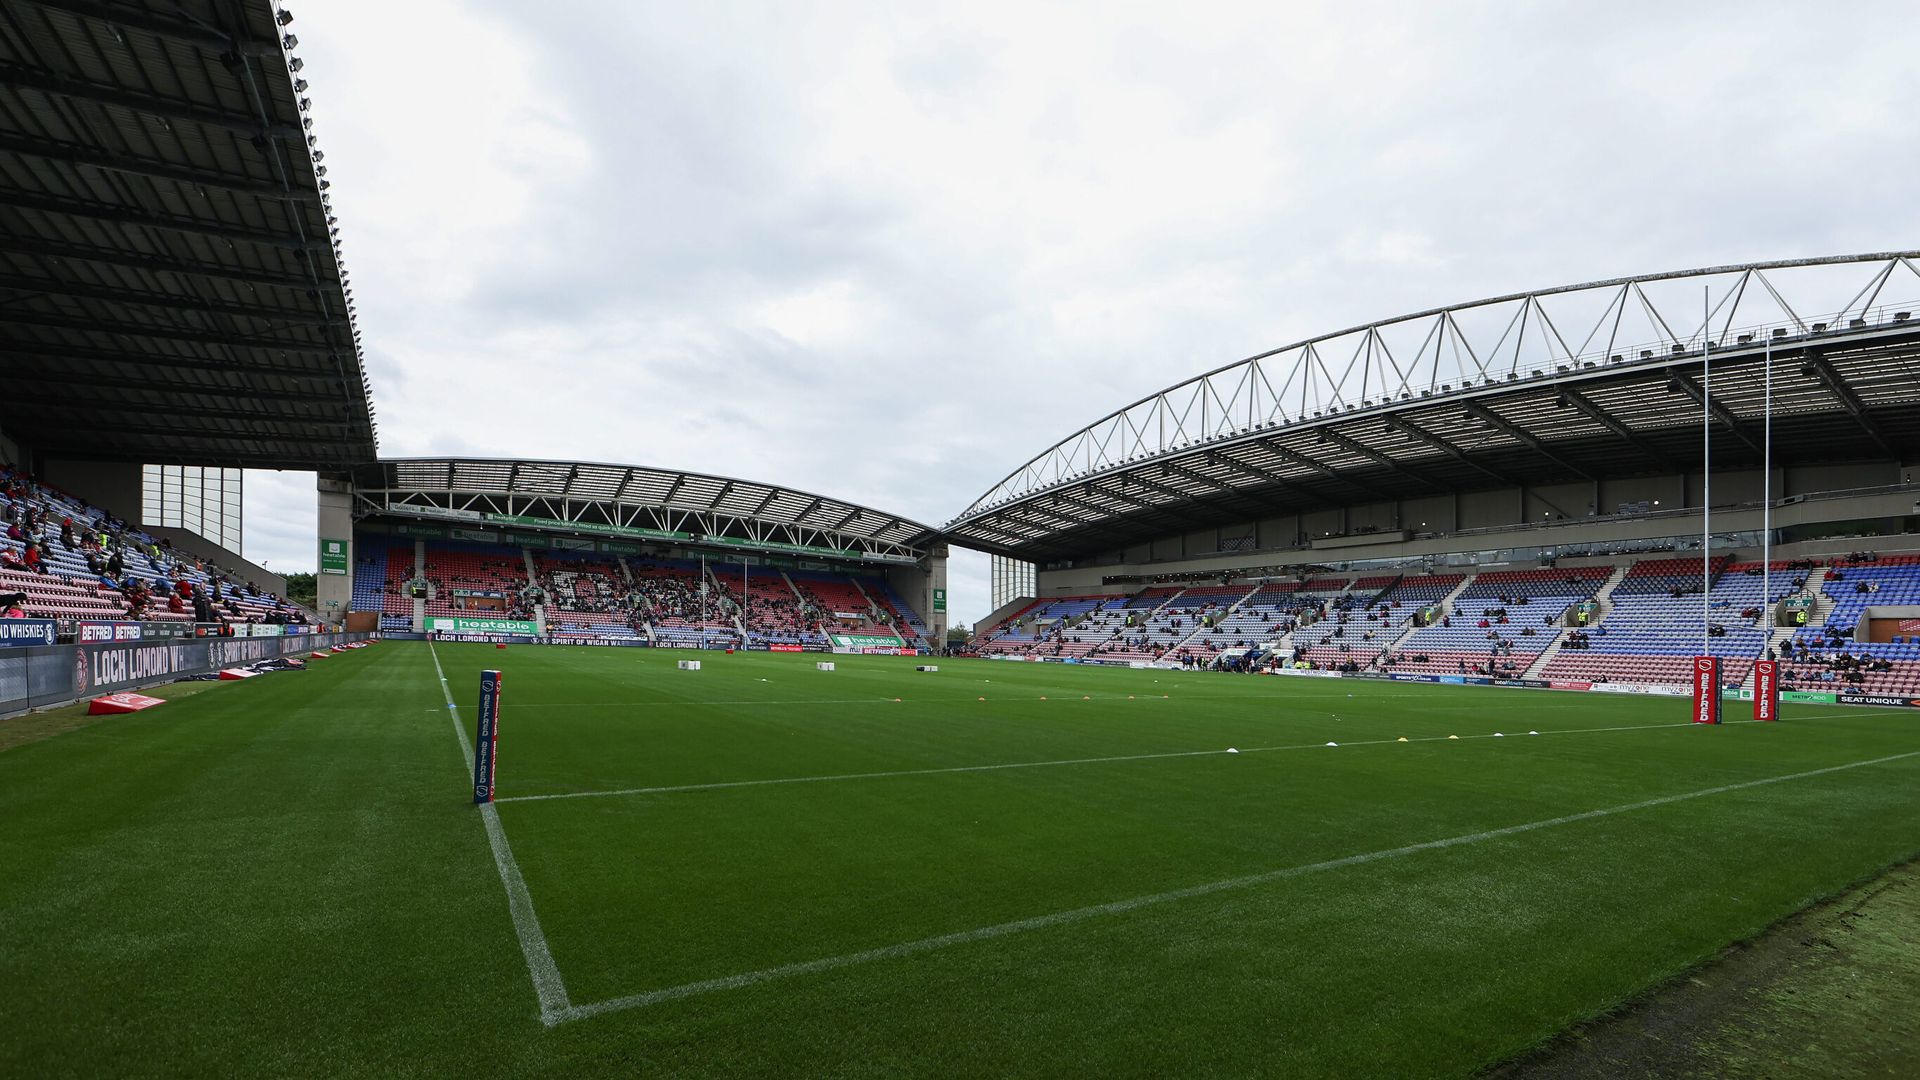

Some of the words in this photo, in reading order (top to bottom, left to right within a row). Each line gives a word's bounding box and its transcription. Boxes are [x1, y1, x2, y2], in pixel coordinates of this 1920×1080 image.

[9, 624, 44, 639] WHISKIES
[459, 619, 529, 629] heatable
[82, 626, 112, 640] BETFRED
[115, 625, 140, 640] BETFRED
[457, 635, 489, 643] LOMOND
[851, 637, 898, 645] heatable
[93, 649, 126, 686] LOCH
[129, 646, 168, 680] LOMOND
[1700, 672, 1709, 721] BETFRED
[1760, 675, 1769, 719] BETFRED
[1866, 697, 1903, 705] UNIQUE
[482, 694, 490, 737] BETFRED
[479, 741, 488, 784] BETFRED
